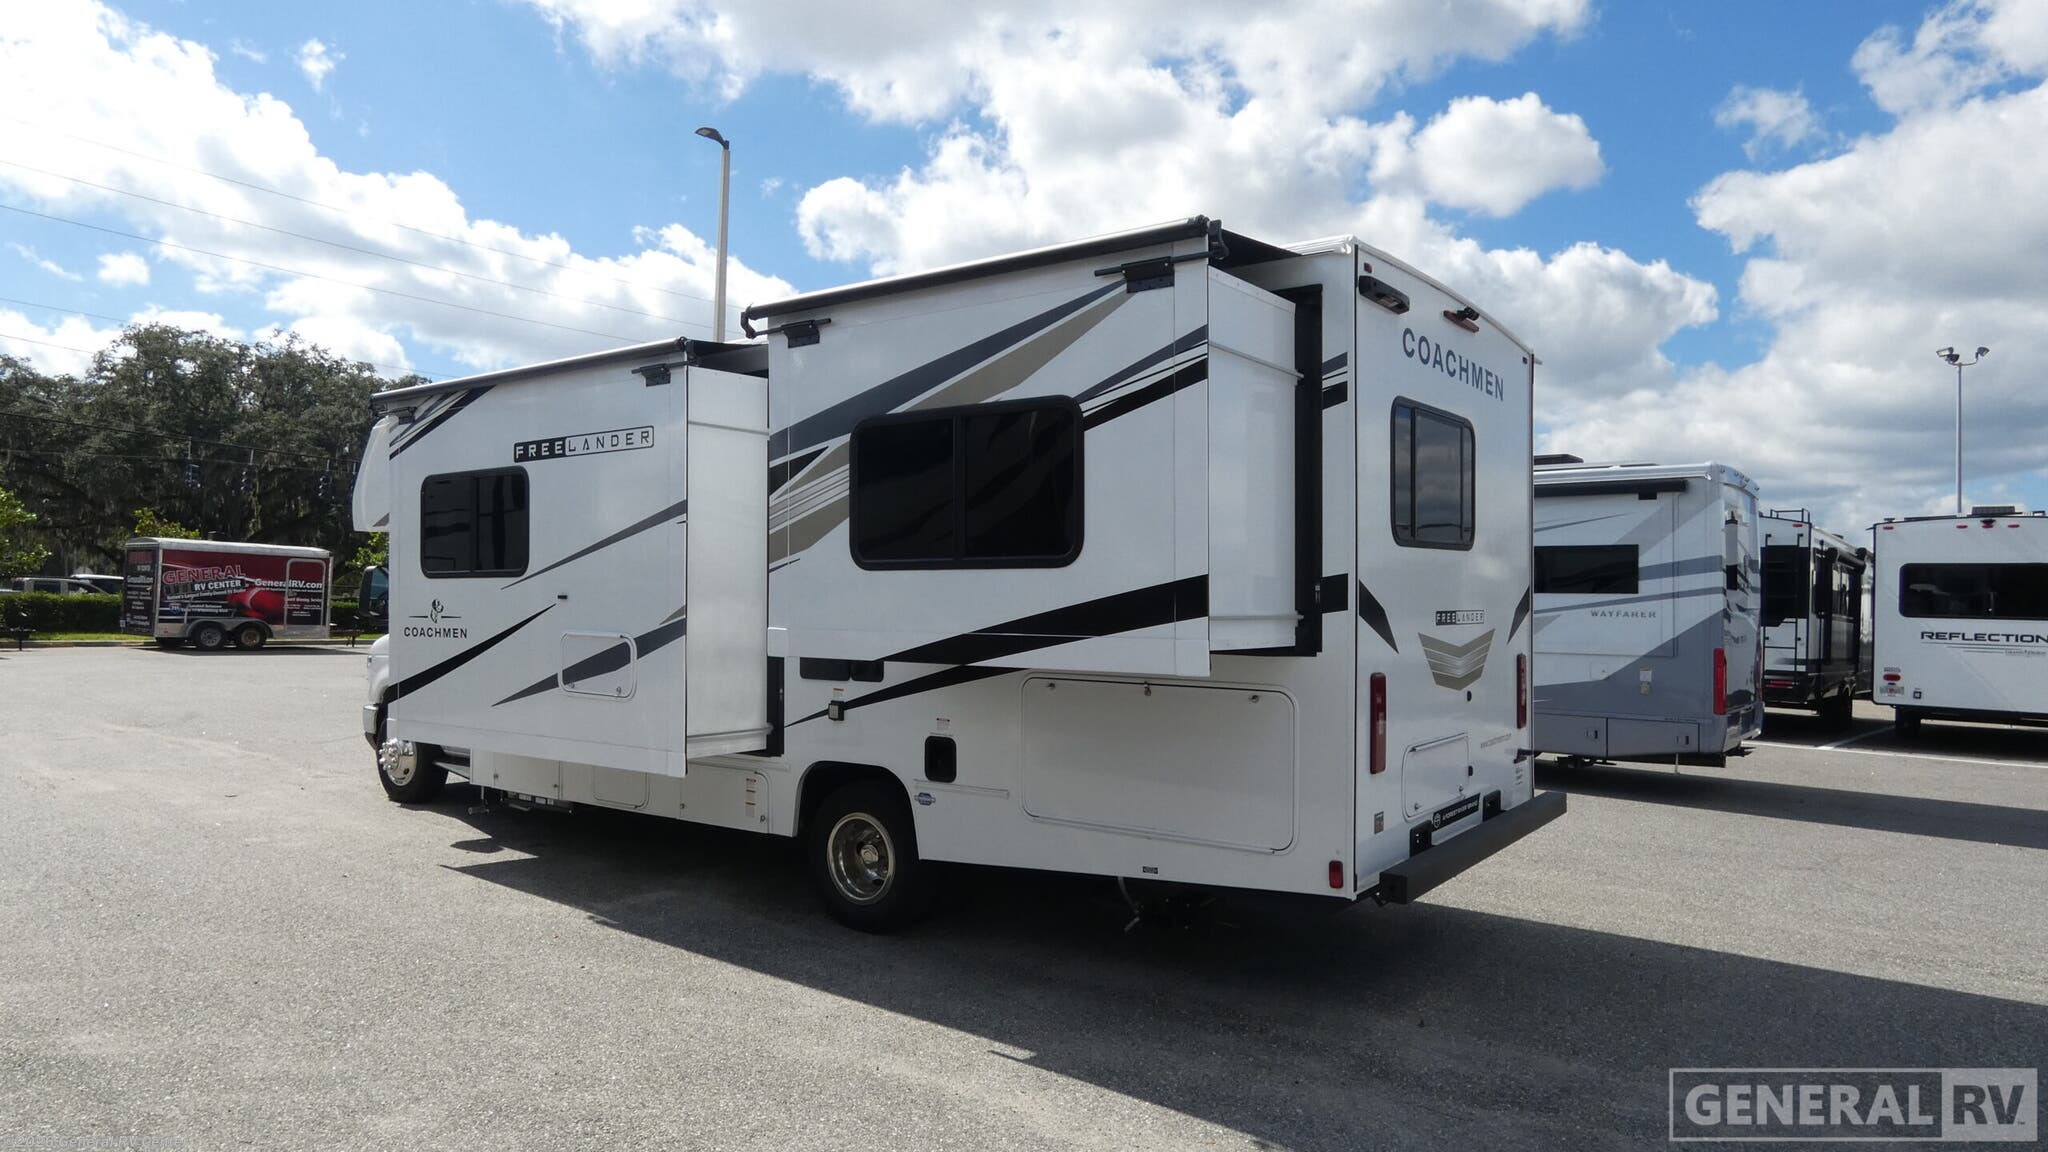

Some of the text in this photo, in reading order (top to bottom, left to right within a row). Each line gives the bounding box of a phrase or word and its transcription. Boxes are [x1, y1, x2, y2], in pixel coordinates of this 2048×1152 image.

[1403, 328, 1504, 400] COACHMEN
[515, 430, 651, 459] FREELANDER
[163, 564, 246, 584] GENERAL
[194, 580, 241, 591] RV CENTER
[1591, 609, 1657, 618] WAYFARER
[404, 626, 467, 639] COACHMEN
[1920, 631, 2048, 644] REFLECTION
